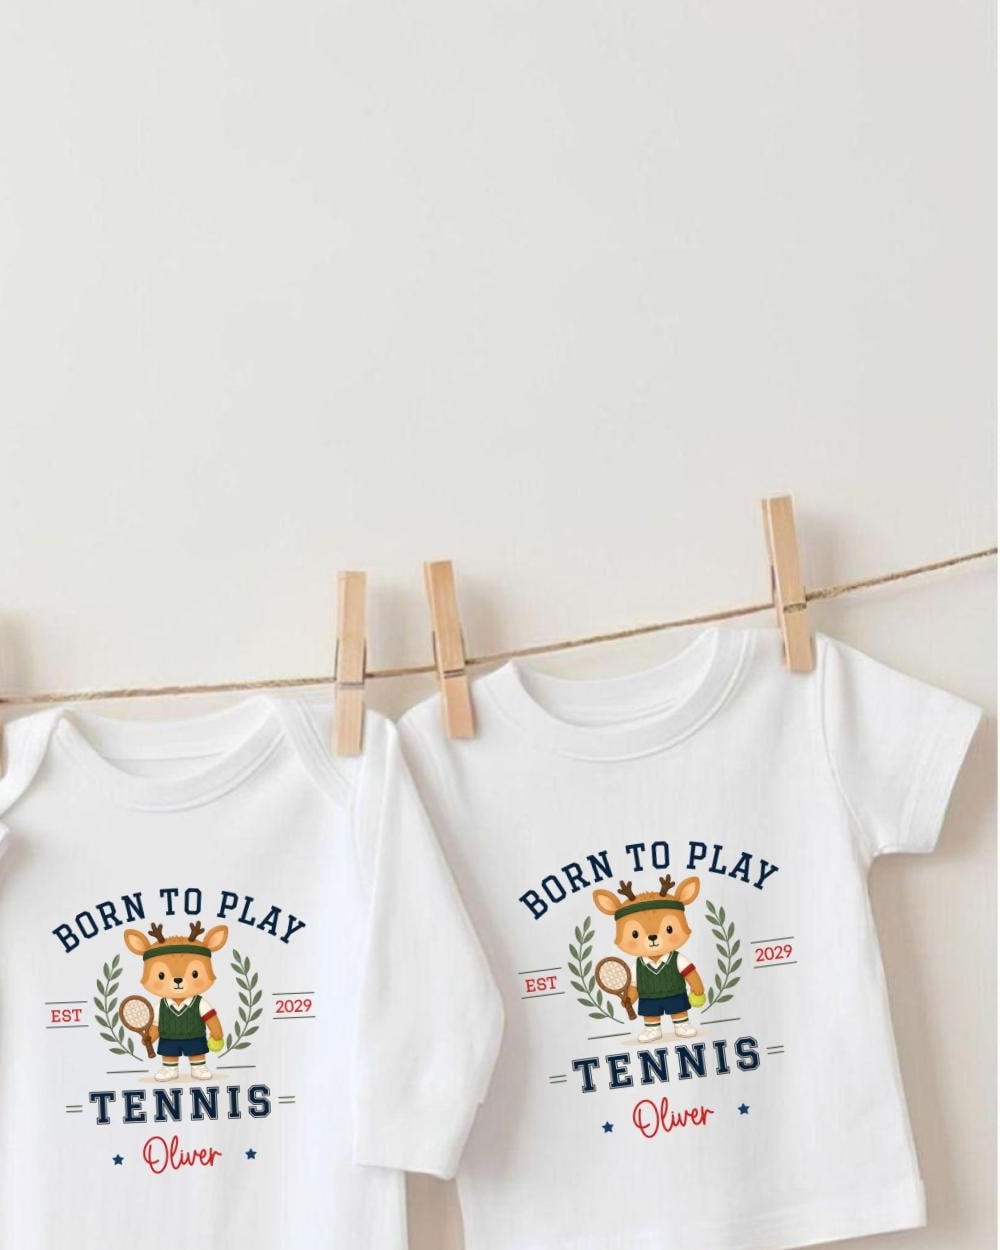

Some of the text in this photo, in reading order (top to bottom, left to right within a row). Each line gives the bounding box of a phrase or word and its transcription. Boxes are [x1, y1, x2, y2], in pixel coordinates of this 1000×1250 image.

[518, 840, 778, 921] BORN TO PLAY
[51, 887, 307, 954] BORN TO PLAY
[755, 943, 793, 963] 2029
[525, 975, 557, 993] EST
[51, 1008, 82, 1023] EST
[276, 998, 313, 1014] 2029
[571, 1035, 761, 1094] TENNIS
[88, 1084, 272, 1126] TENNIS
[631, 1096, 713, 1140] Oliver
[141, 1135, 222, 1176] Oliver
